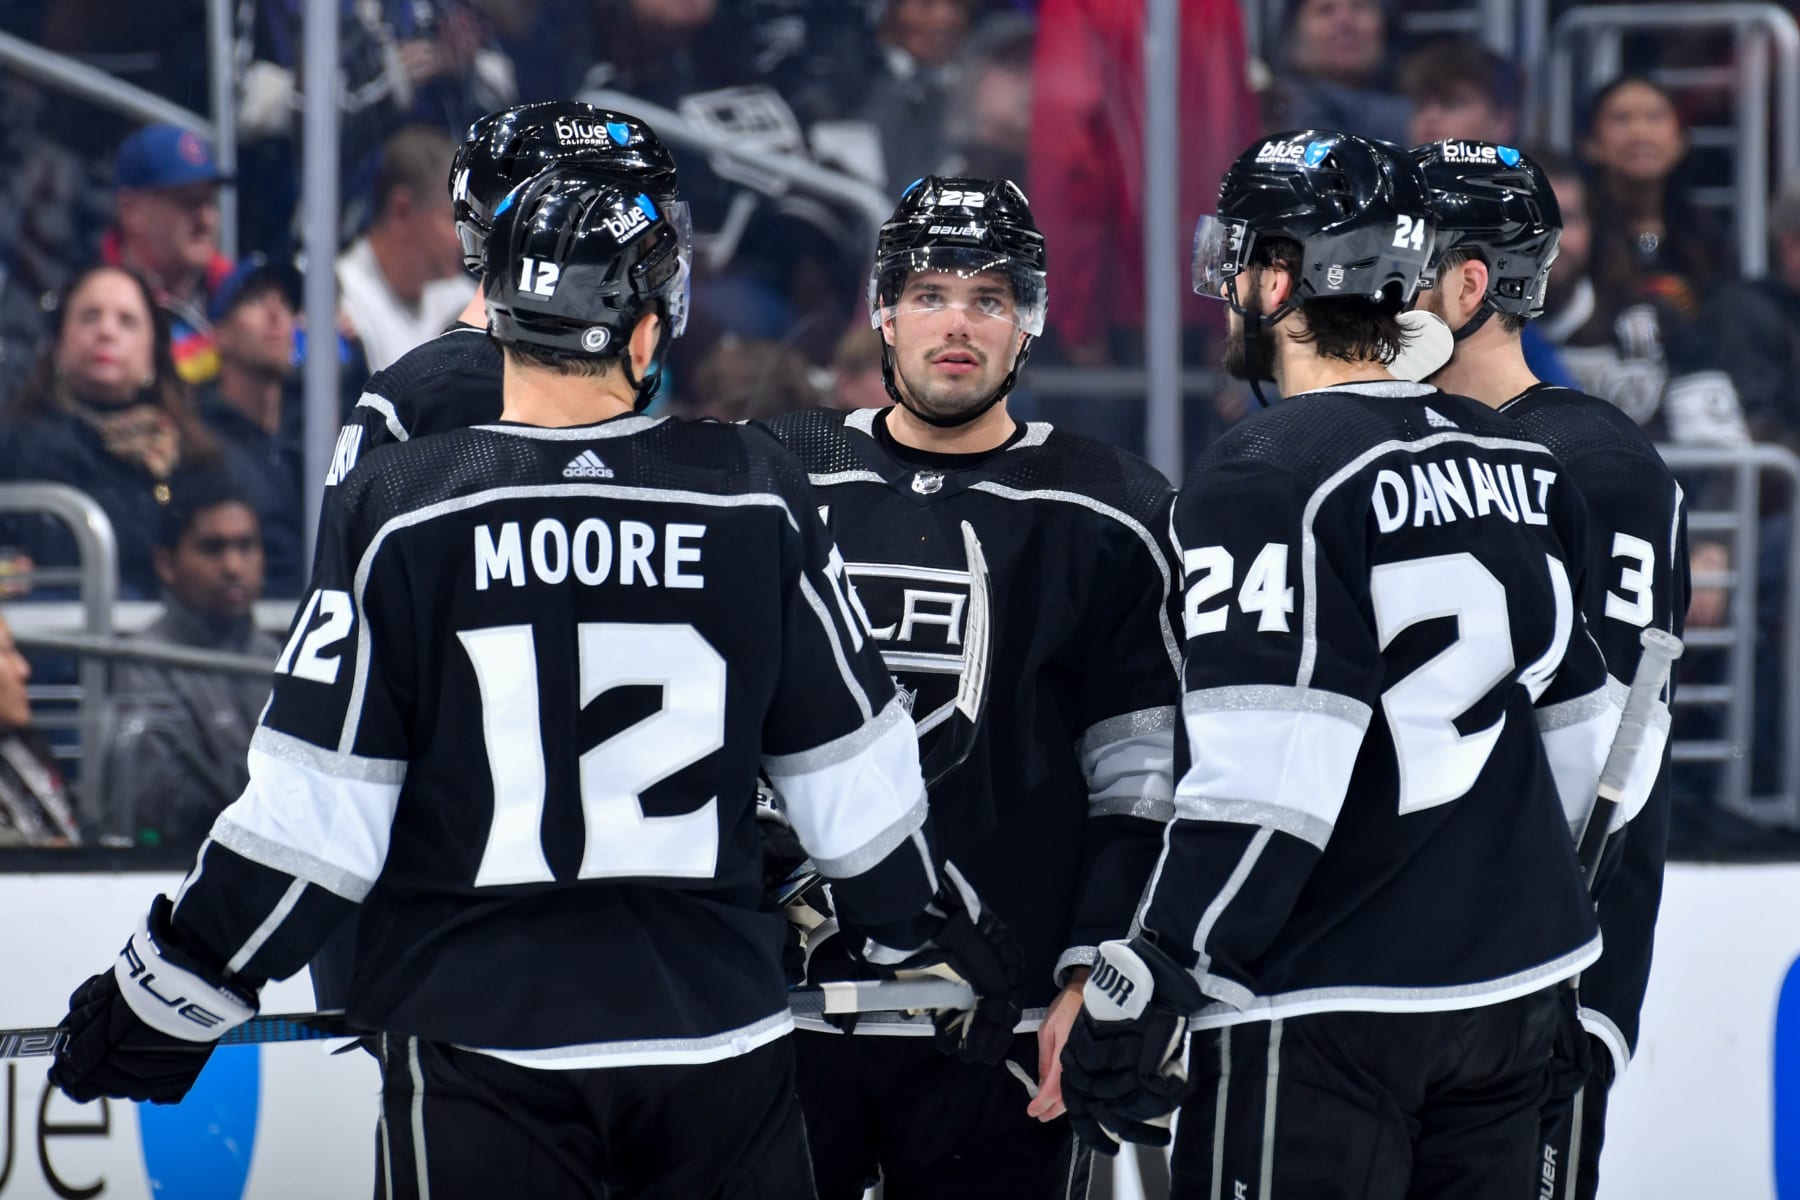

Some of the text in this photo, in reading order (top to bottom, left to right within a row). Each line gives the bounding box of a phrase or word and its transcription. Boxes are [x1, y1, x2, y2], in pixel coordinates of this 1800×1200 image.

[555, 121, 607, 139] blue
[1258, 141, 1305, 158] blue
[1443, 140, 1496, 158] blue
[1444, 156, 1497, 164] CALIFORNIA
[938, 189, 985, 208] 22
[603, 206, 646, 238] blue
[928, 225, 986, 239] BAUER
[1391, 214, 1425, 251] 24
[519, 257, 559, 296] 12
[562, 466, 615, 479] adidas
[1372, 457, 1557, 534] DANAULT
[474, 518, 706, 590] MOORE
[1182, 542, 1295, 641] 24
[1605, 532, 1655, 628] 3
[274, 588, 354, 684] 12
[456, 622, 727, 888] 12
